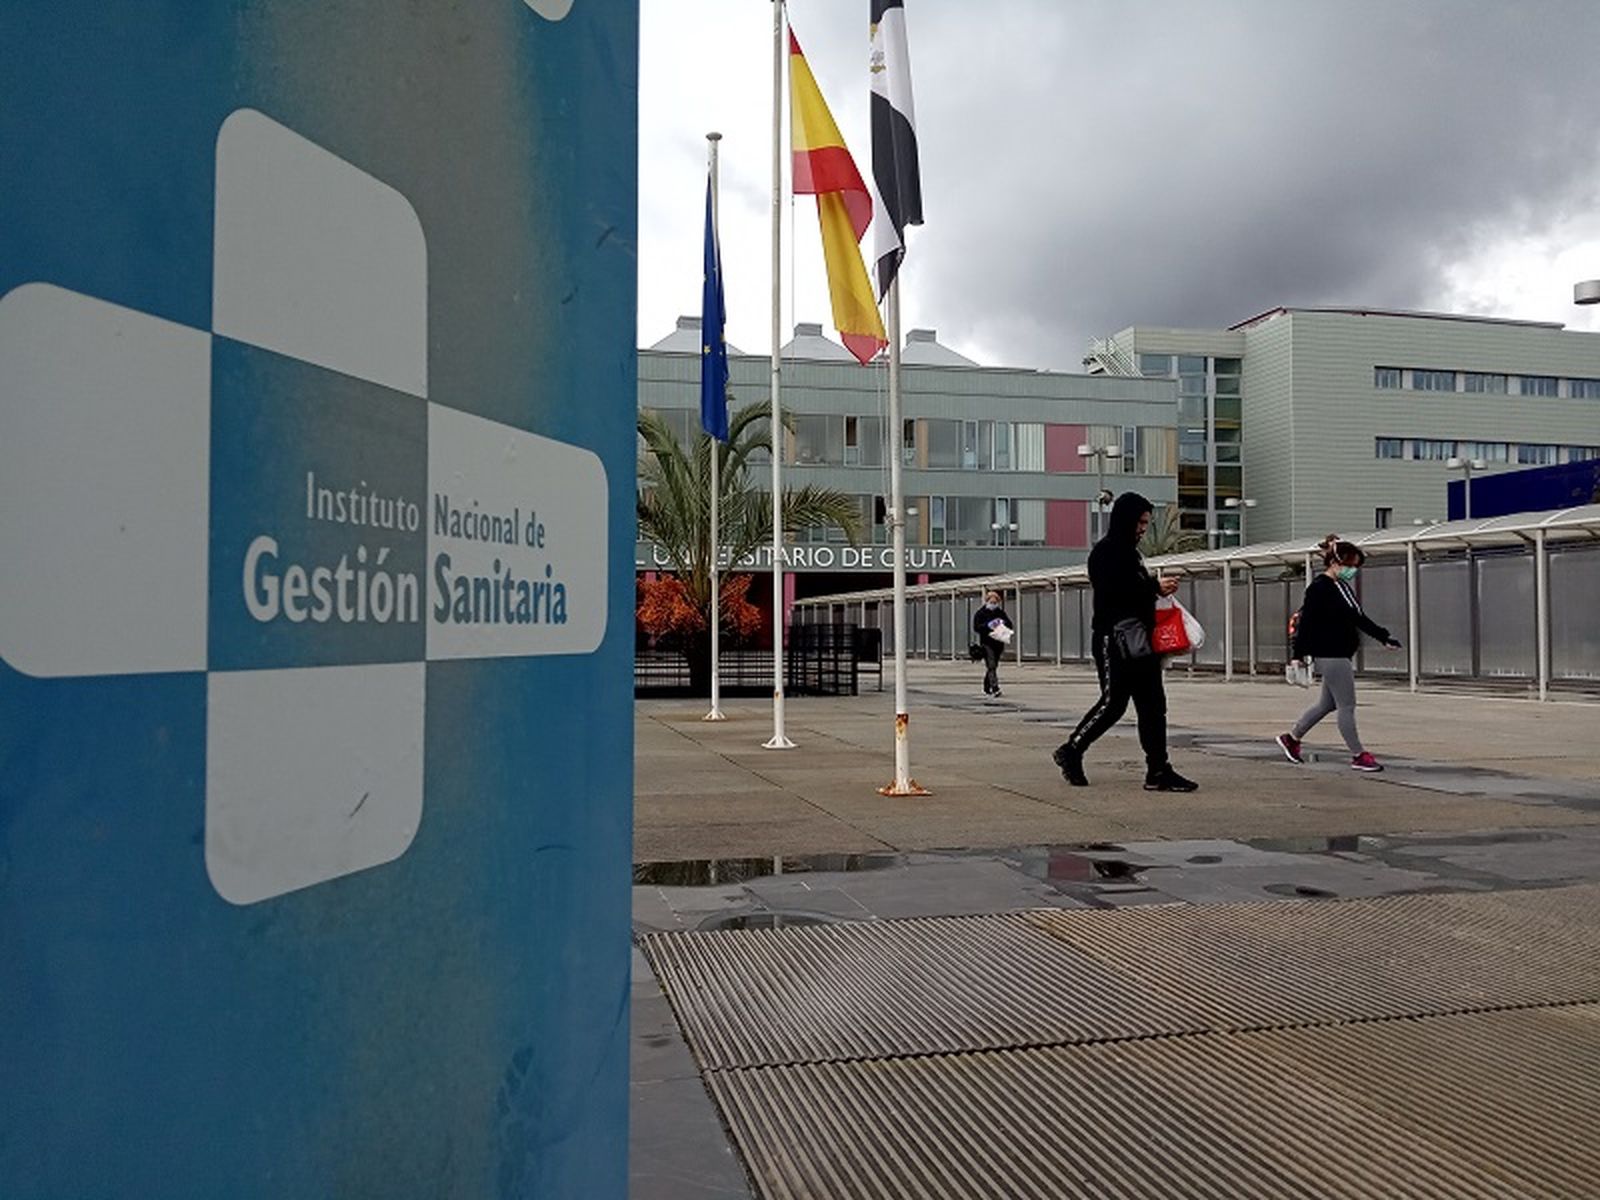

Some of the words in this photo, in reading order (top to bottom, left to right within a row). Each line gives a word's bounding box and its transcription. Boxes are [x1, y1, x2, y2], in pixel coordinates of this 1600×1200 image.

[306, 471, 419, 532] Instituto
[434, 493, 519, 545] Nacional
[525, 511, 546, 549] de
[243, 535, 419, 623] Gestión
[433, 552, 567, 625] Sanitaria
[653, 545, 835, 567] UNIERSITARIO
[842, 547, 873, 567] DE
